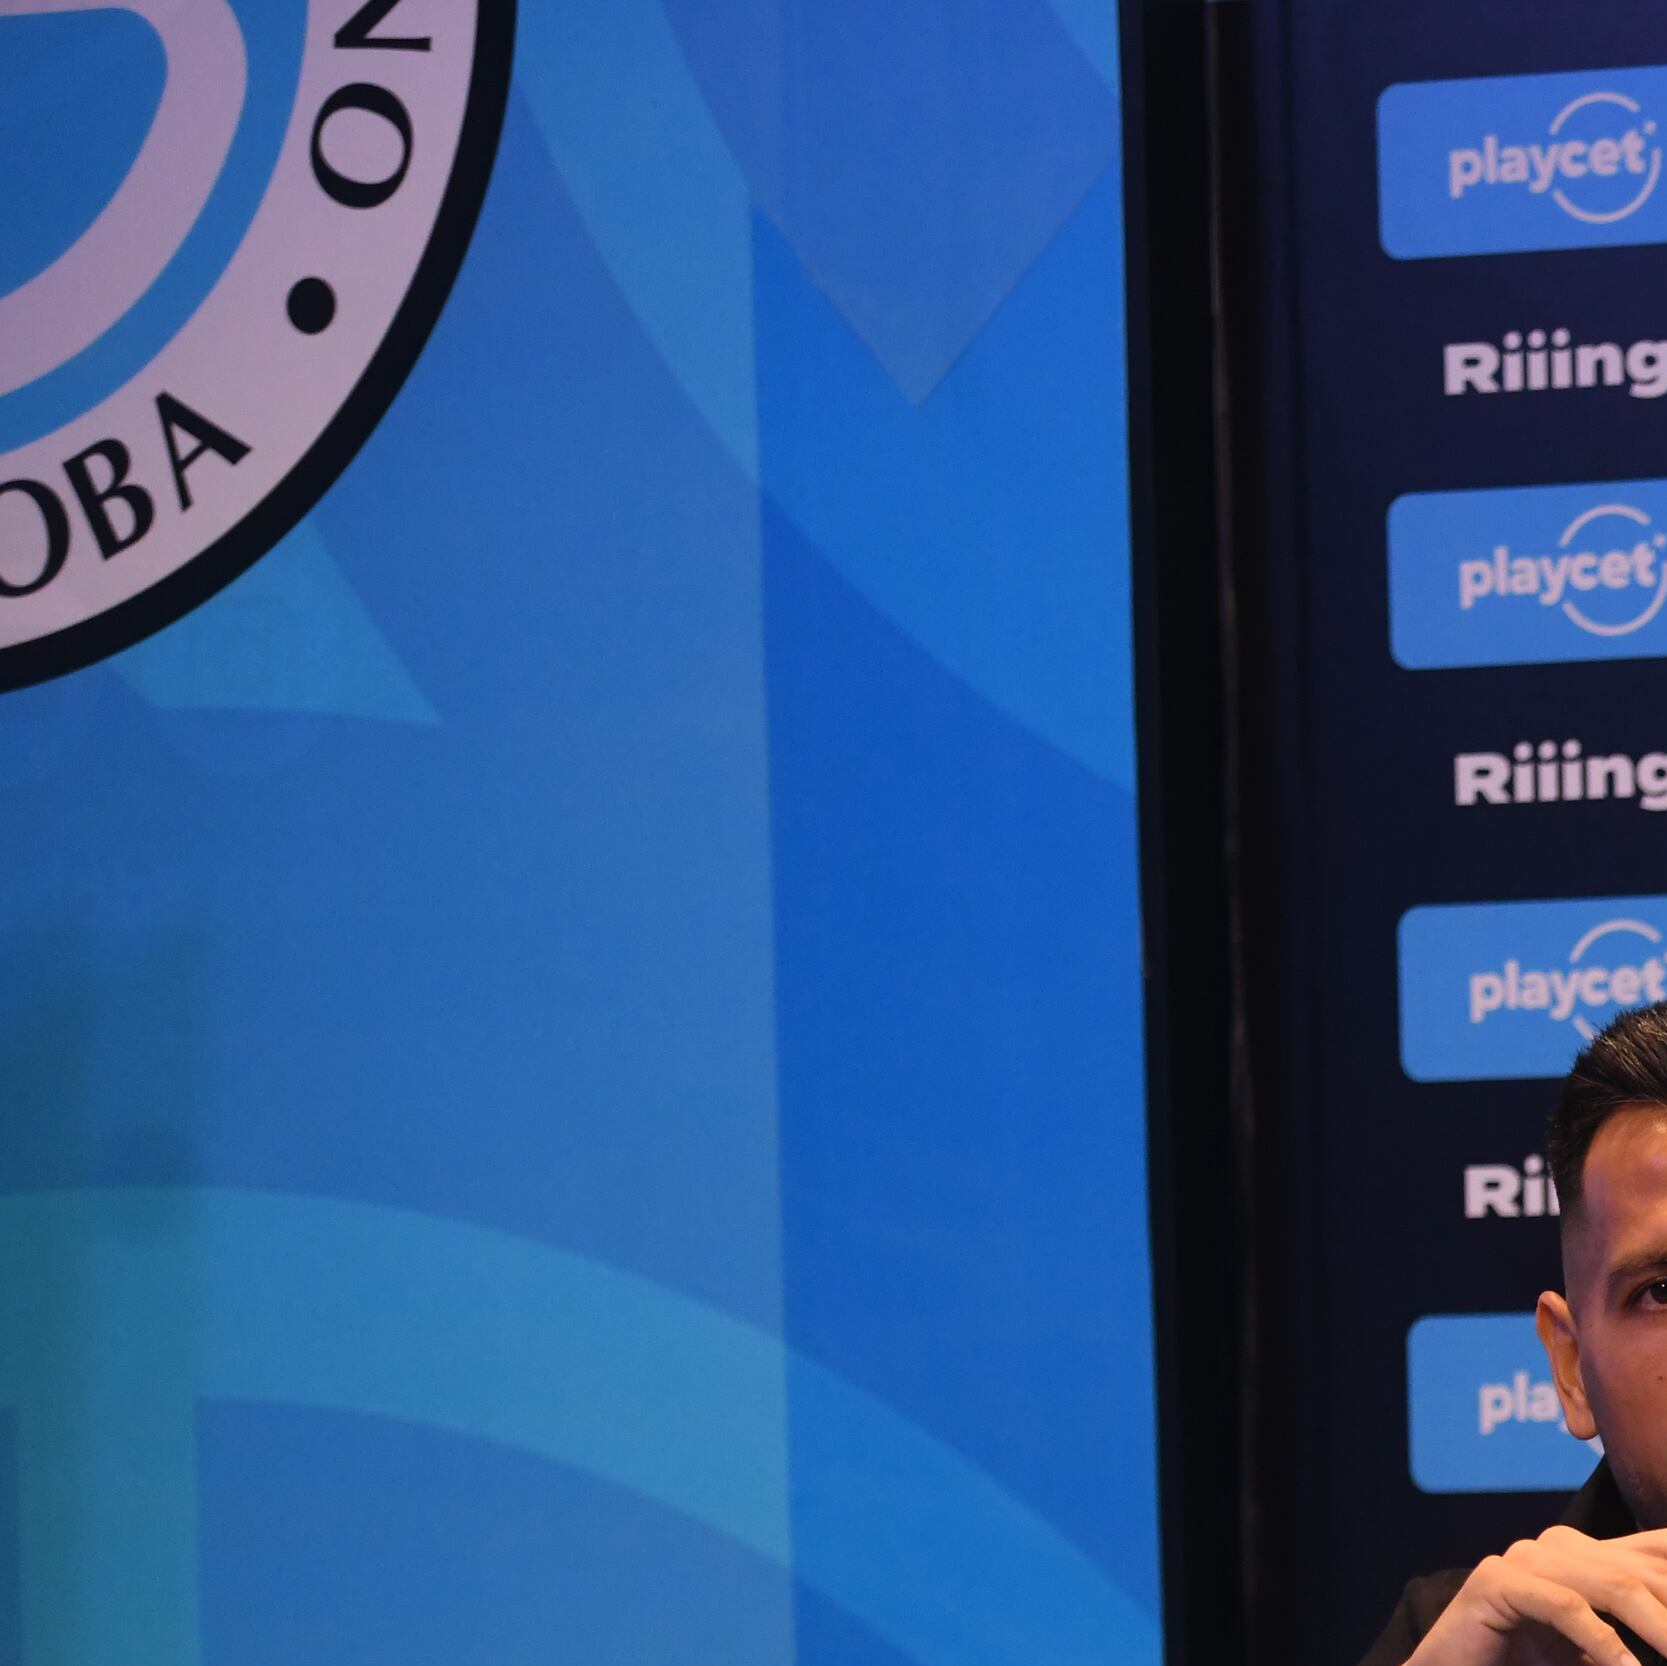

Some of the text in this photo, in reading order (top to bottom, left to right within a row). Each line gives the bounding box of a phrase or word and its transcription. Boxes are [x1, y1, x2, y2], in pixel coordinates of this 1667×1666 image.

[1449, 127, 1647, 202] playcet
[1459, 539, 1657, 611] playcet
[1470, 958, 1665, 1024] playcet
[1478, 1368, 1568, 1436] pla
